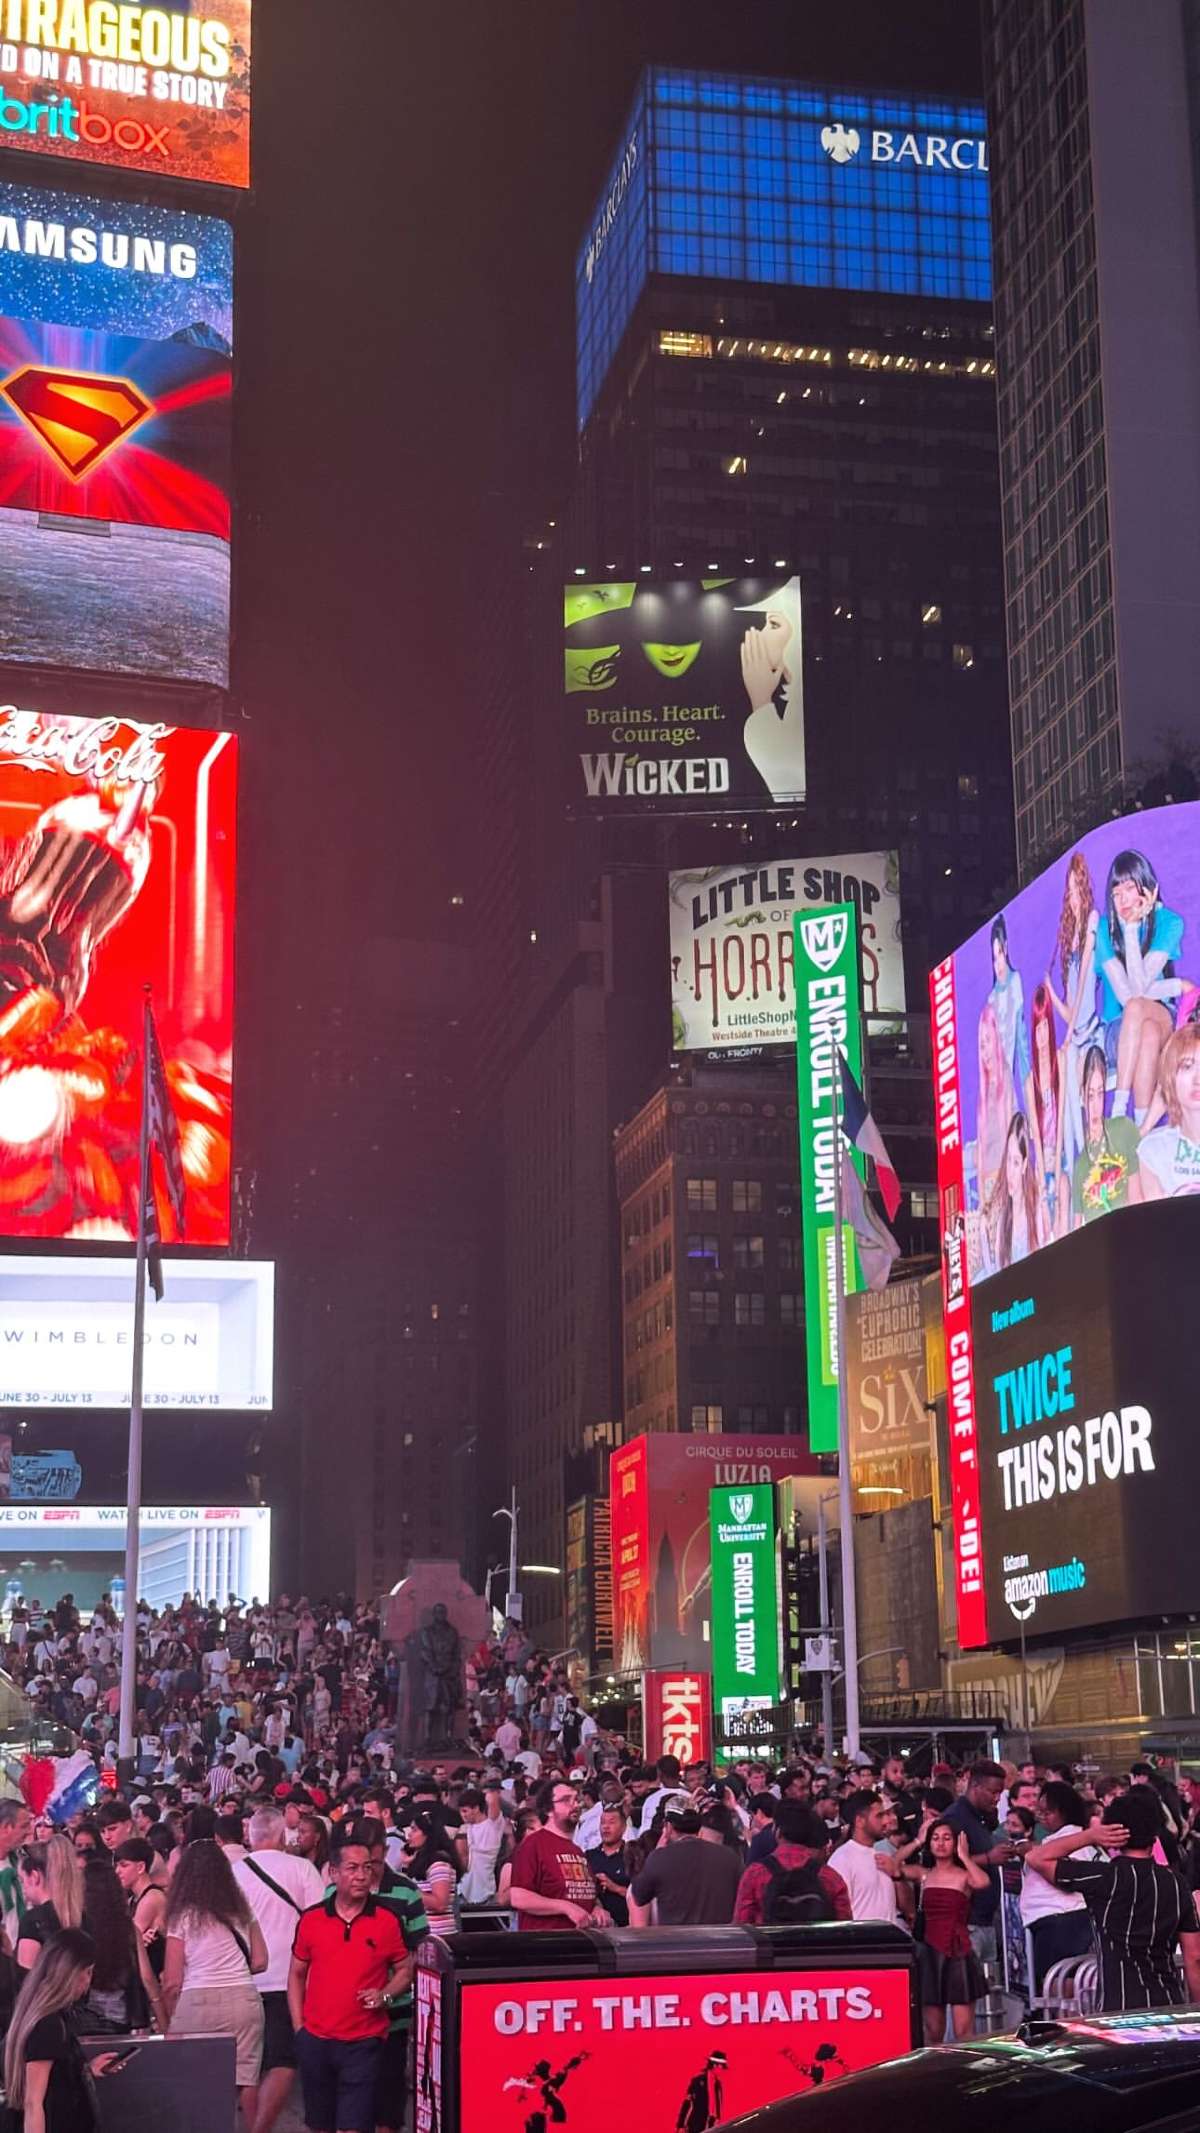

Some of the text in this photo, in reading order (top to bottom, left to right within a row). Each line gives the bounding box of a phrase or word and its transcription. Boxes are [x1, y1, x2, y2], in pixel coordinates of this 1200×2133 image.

[24, 47, 60, 80] ON
[65, 55, 83, 85] A
[88, 58, 147, 97] TRUE
[152, 70, 229, 110] STORY
[586, 704, 726, 725] Brains. Heart.
[611, 726, 701, 746] Courage.
[692, 867, 881, 930] LITTLE SHOP
[770, 911, 791, 923] OF
[711, 1030, 754, 1041] Westside
[754, 1027, 789, 1038] Theatre
[860, 1281, 920, 1312] BROADWAY'S
[25, 1392, 40, 1402] 30
[51, 1393, 78, 1402] JULY
[82, 1393, 93, 1403] 13
[154, 1394, 169, 1404] 30
[178, 1394, 207, 1404] JULY
[209, 1394, 220, 1404] 13
[994, 1346, 1075, 1434] TWICE
[685, 1446, 798, 1460] CIRQUE DU SOLEIL
[998, 1405, 1155, 1511] THIS IS FOR
[715, 1464, 772, 1485] LUZIA
[18, 1510, 38, 1520] ON
[43, 1510, 81, 1520] ESPN
[147, 1509, 177, 1520] LIVE
[179, 1509, 199, 1519] ON
[204, 1510, 241, 1520] ESPN
[1004, 1556, 1086, 1604] amazon music
[733, 1552, 756, 1676] ENROLL TODAY
[662, 1677, 701, 1764] tkts
[494, 1986, 882, 2034] OFF. THE. CHARTS.
